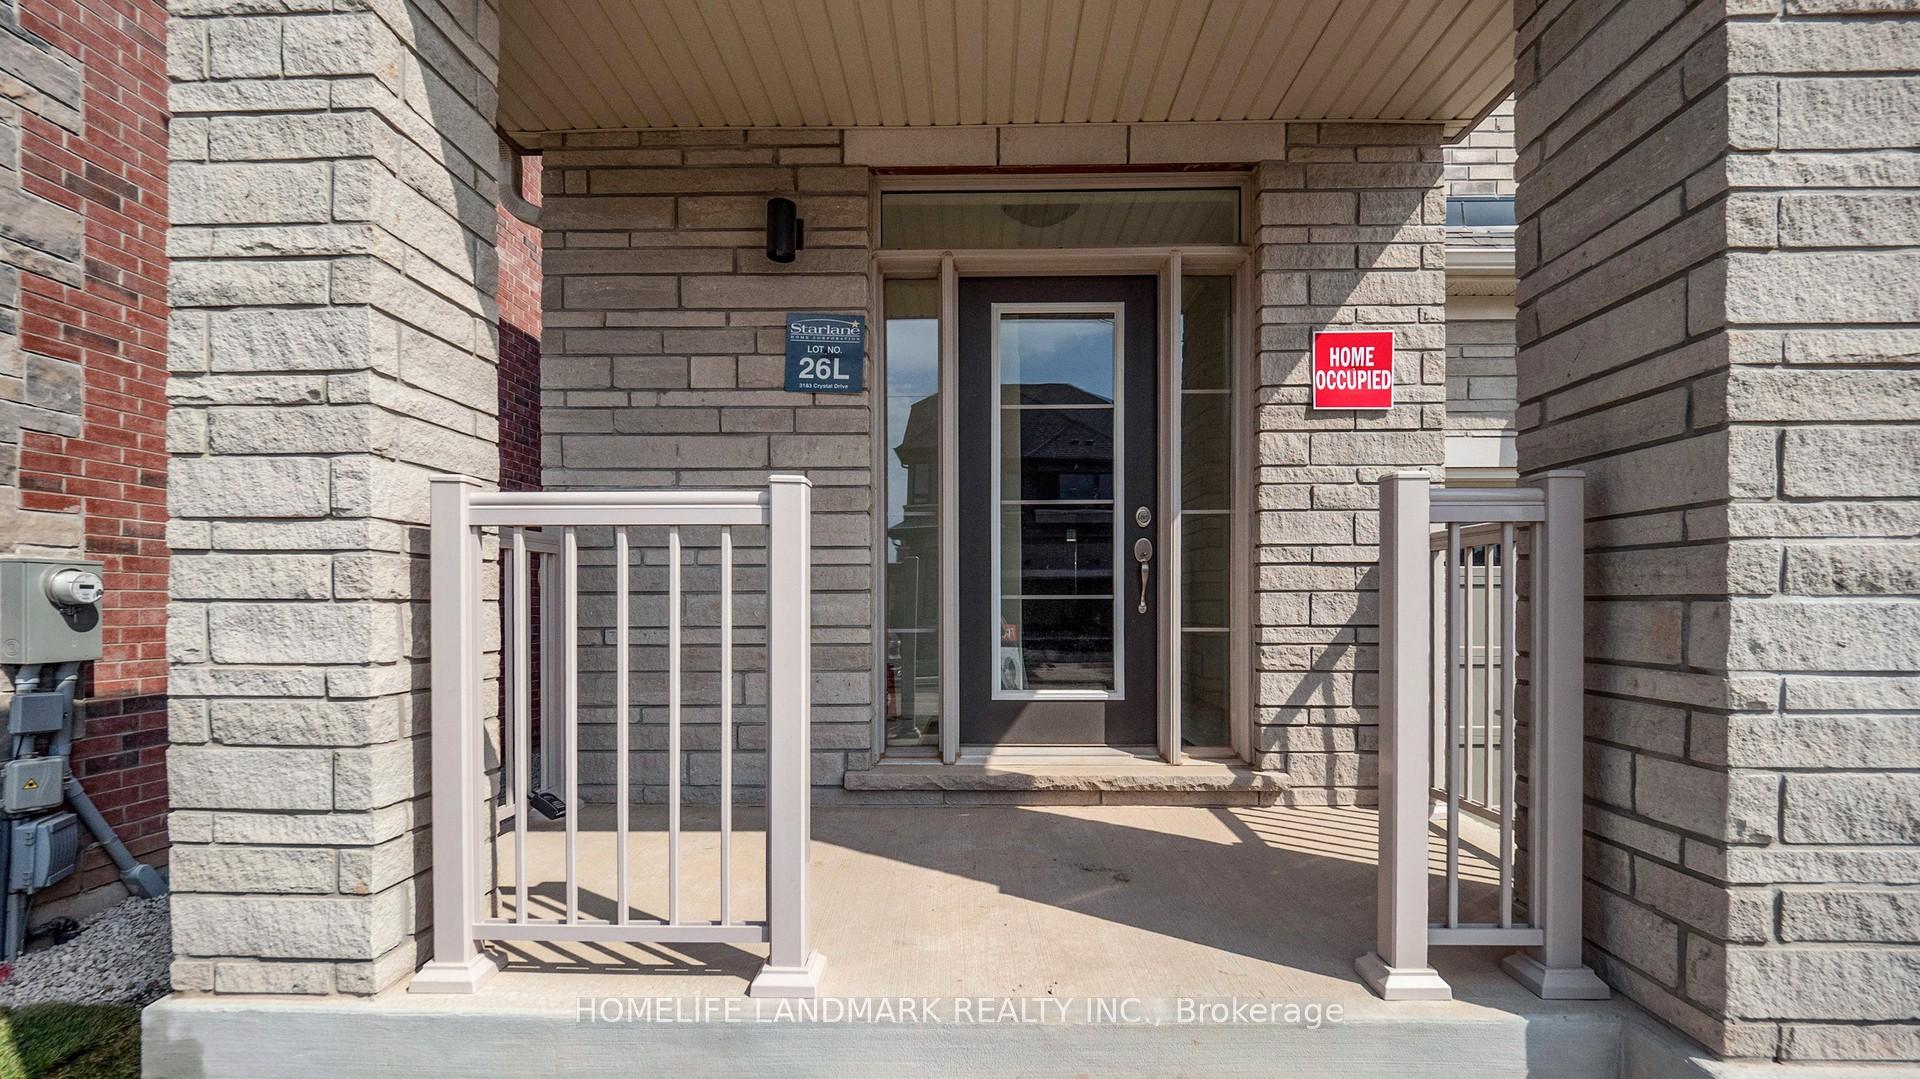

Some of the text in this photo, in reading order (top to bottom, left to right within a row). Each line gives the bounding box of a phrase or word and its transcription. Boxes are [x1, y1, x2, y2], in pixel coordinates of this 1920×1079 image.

[790, 322, 860, 335] Starlane
[807, 345, 843, 354] LOT NO.
[1329, 346, 1375, 367] HOME
[799, 357, 849, 380] 26L
[1316, 369, 1391, 390] OCCUPIED
